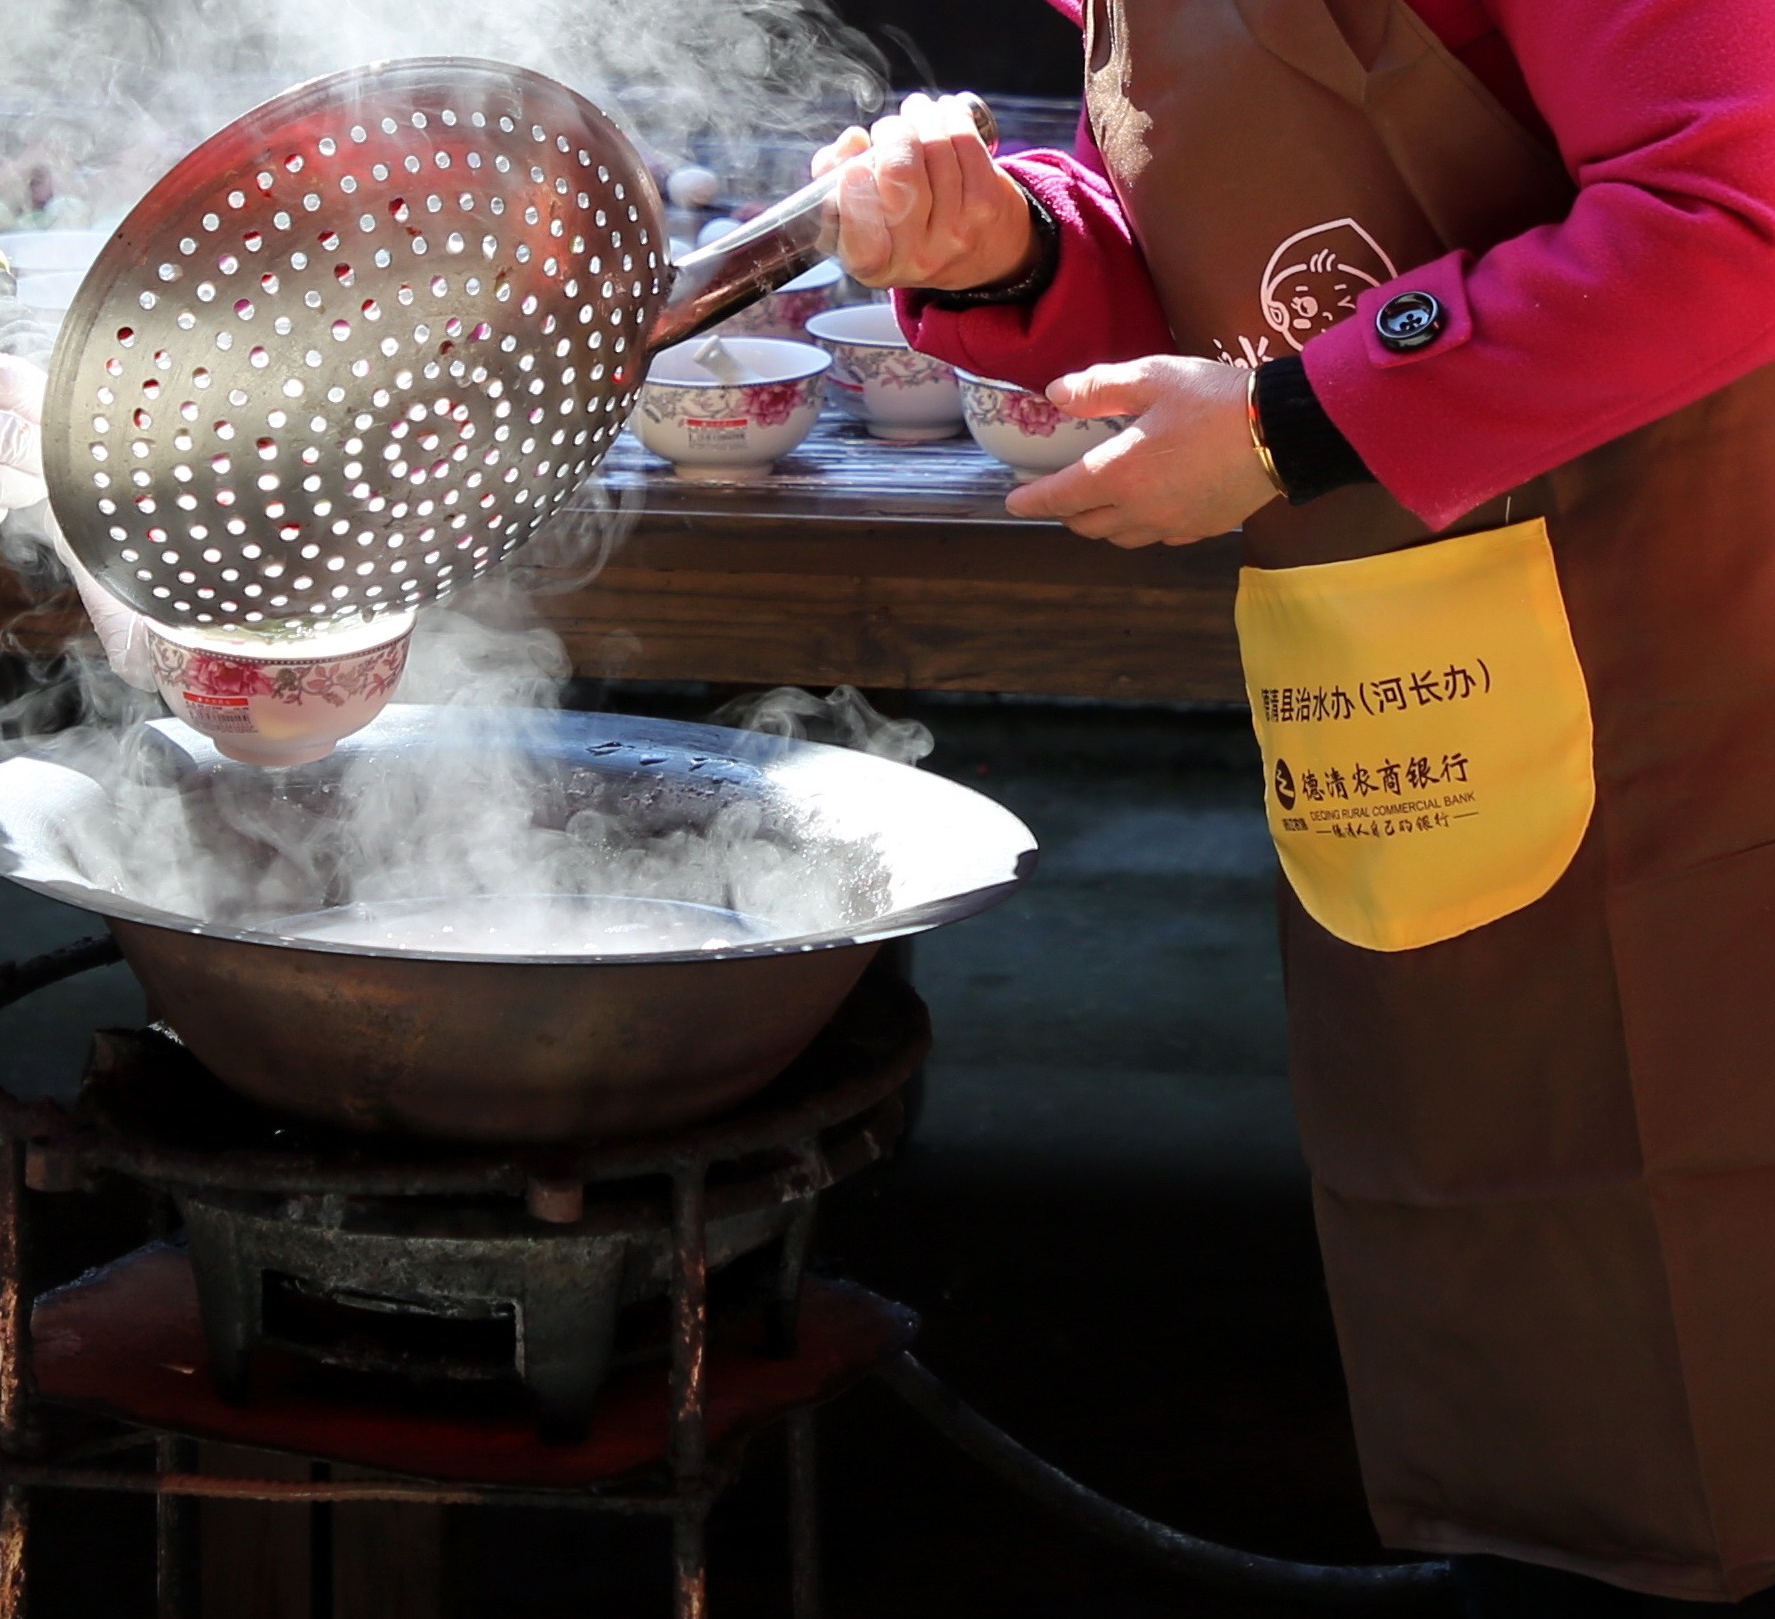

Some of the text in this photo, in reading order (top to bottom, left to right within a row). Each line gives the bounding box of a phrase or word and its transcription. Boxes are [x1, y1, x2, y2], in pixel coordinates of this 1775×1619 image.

[1301, 752, 1469, 802] 德清农商银行
[1309, 790, 1477, 822] DEQING RURAL COMMERCIAL BANK
